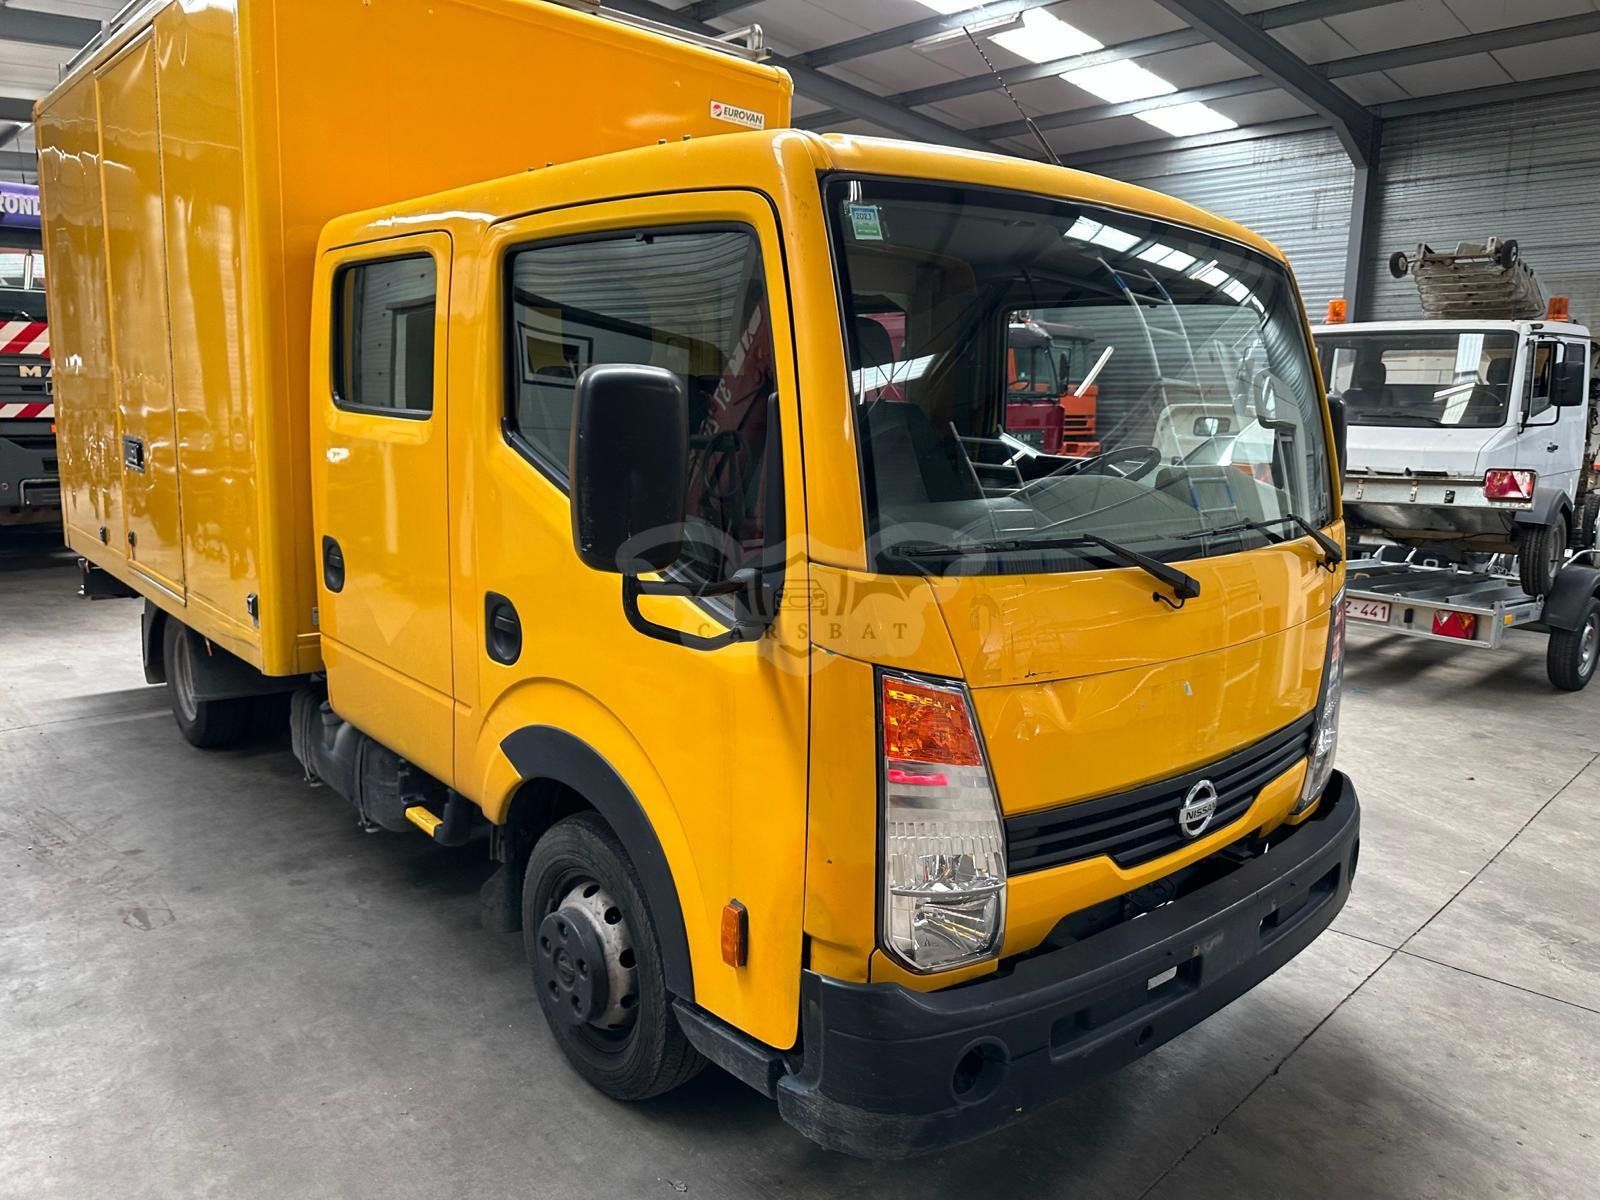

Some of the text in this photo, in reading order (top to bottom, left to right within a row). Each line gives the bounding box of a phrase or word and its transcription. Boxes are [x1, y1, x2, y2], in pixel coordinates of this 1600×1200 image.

[723, 106, 763, 125] EUROVAN
[19, 365, 52, 378] M
[1185, 801, 1216, 820] NISSAN
